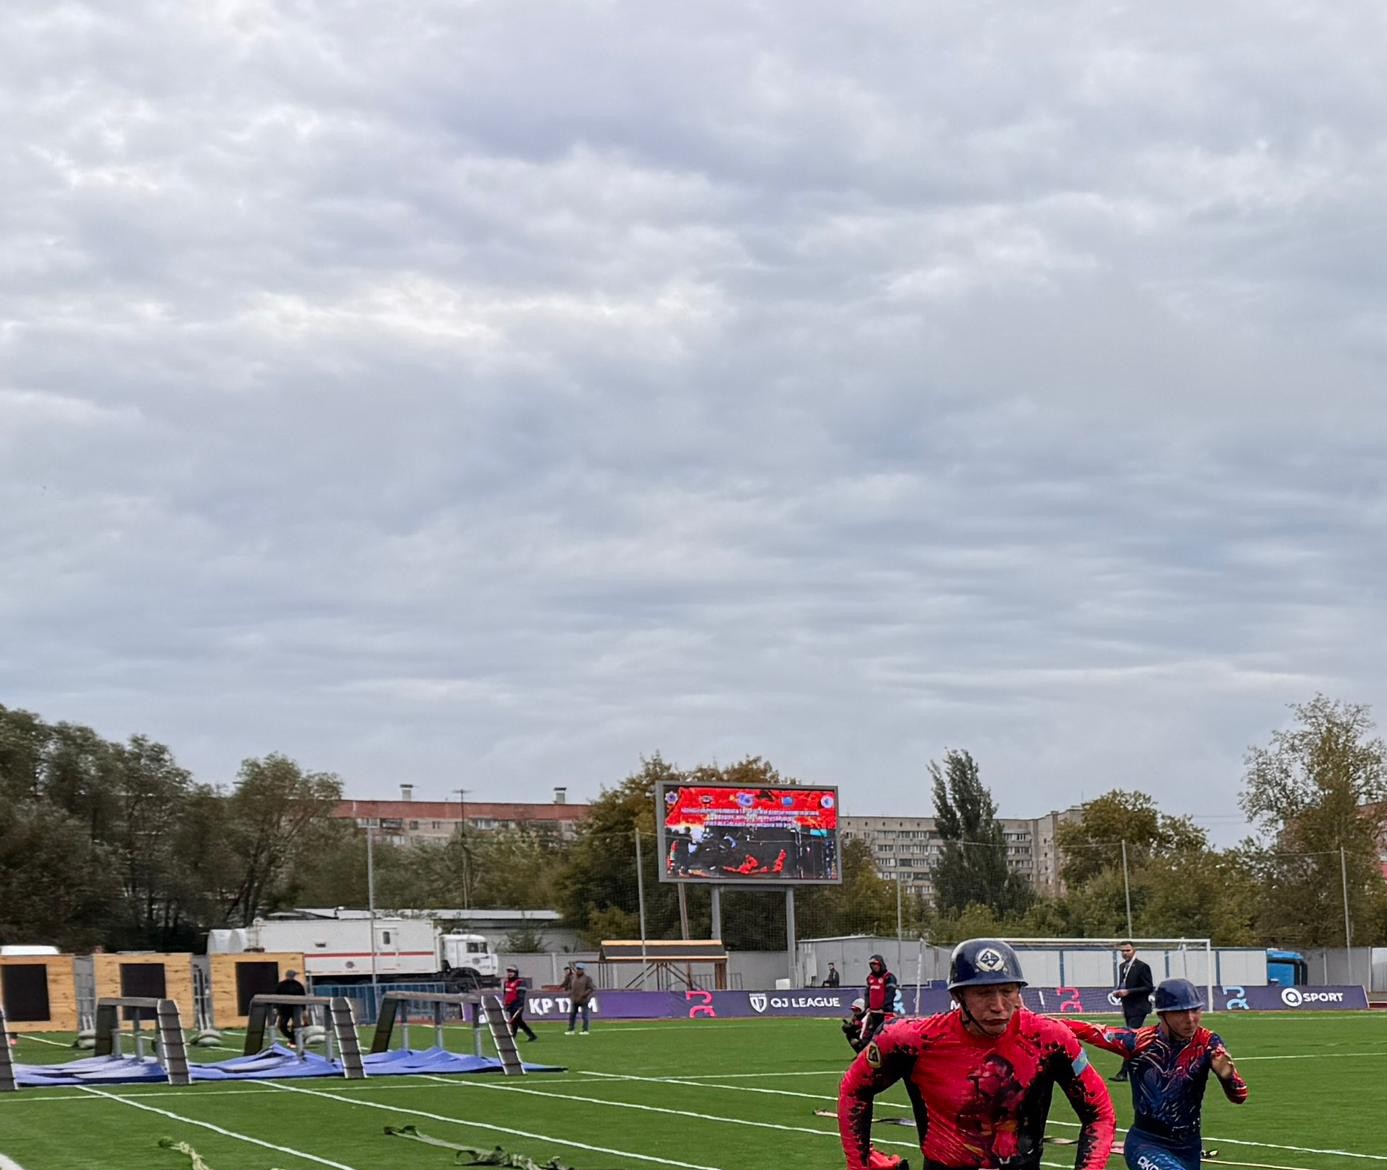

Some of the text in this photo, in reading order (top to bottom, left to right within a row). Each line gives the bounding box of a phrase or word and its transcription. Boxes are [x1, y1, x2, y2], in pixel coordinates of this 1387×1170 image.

[770, 997, 841, 1009] QJ LEAGUE
[1303, 992, 1344, 1003] SPORT
